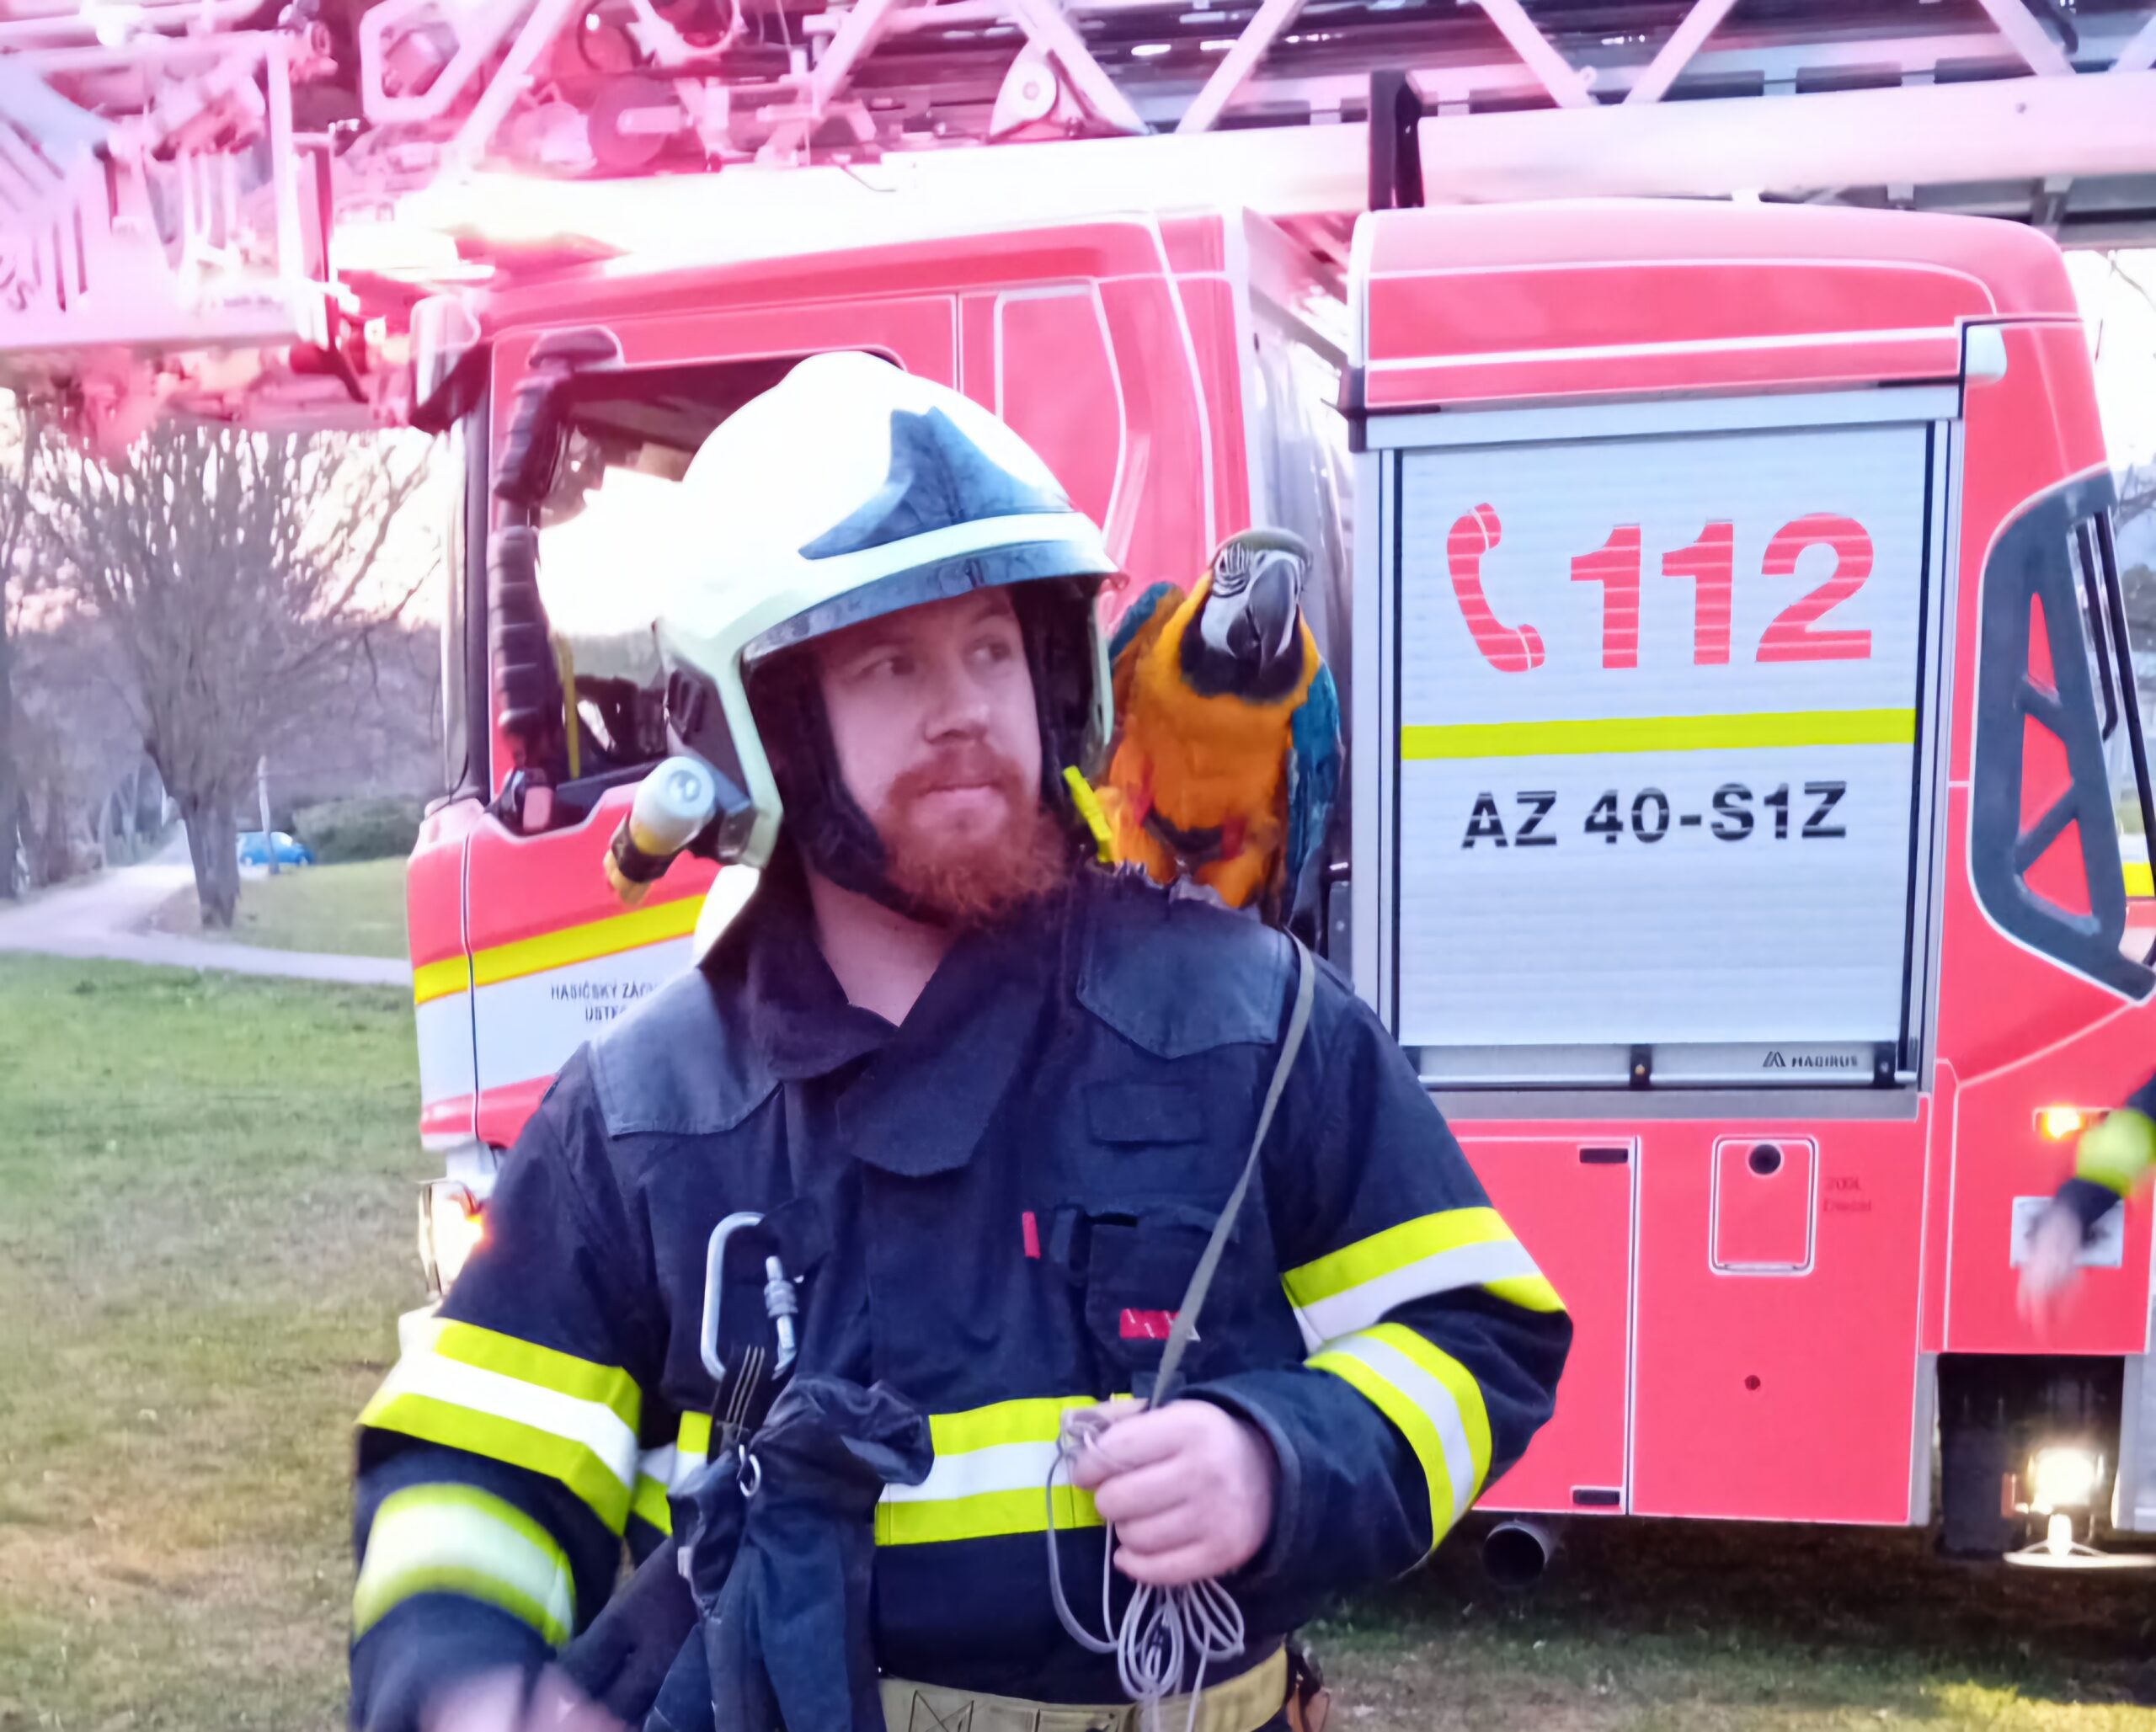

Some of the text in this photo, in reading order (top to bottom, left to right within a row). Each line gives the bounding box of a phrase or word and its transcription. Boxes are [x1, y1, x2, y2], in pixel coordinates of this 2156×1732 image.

[1571, 512, 1874, 669] 112
[1461, 780, 1847, 849] AZ 40-S1Z
